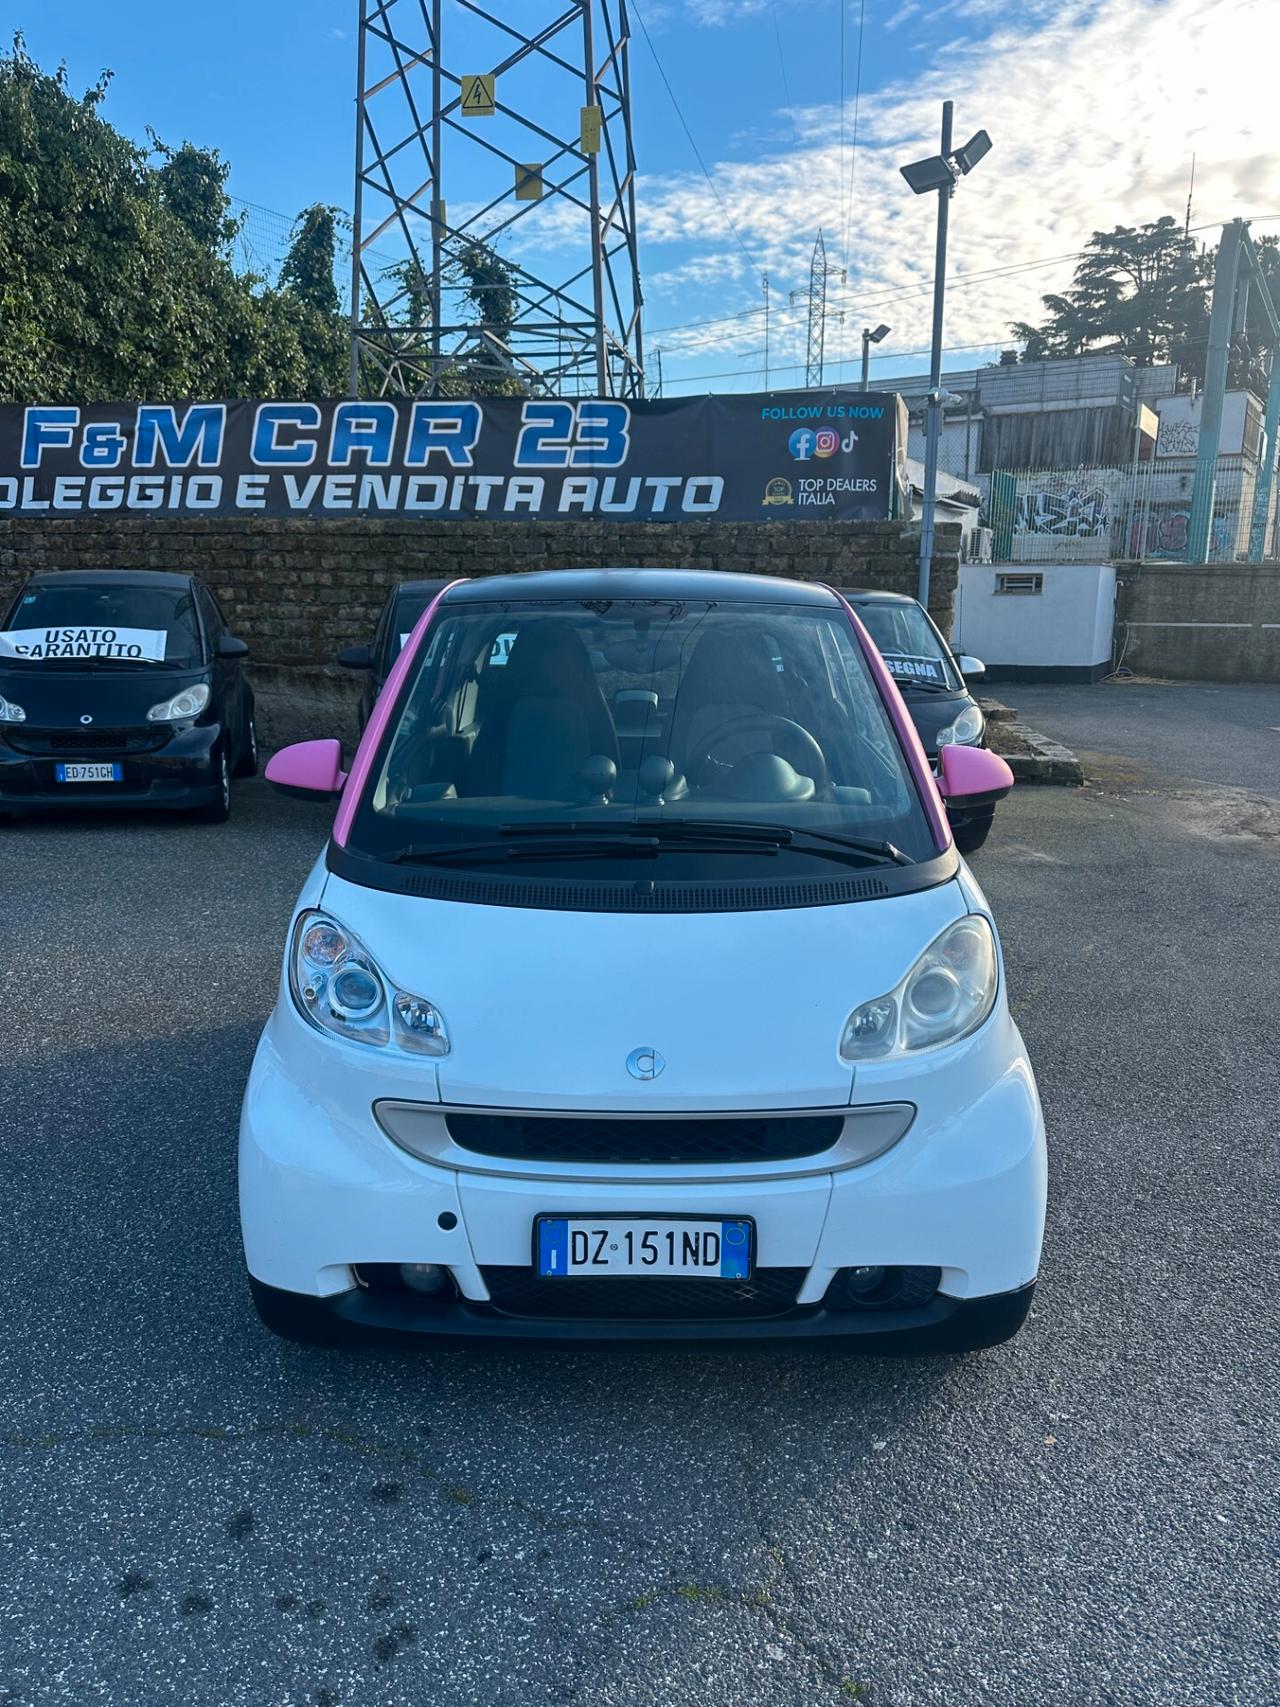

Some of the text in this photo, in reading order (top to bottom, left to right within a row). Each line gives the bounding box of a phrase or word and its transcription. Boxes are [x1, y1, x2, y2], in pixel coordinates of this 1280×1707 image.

[762, 406, 885, 420] FOLLOW US NOW
[20, 401, 631, 469] F&M CAR 23
[798, 479, 877, 492] TOP DEALERS
[235, 474, 270, 509] E
[283, 474, 545, 512] VENDITA
[557, 476, 725, 513] AUTO
[798, 492, 835, 505] ITALIA
[45, 629, 117, 644] USATO
[571, 1230, 609, 1265] DZ
[624, 1230, 720, 1266] 151ND
